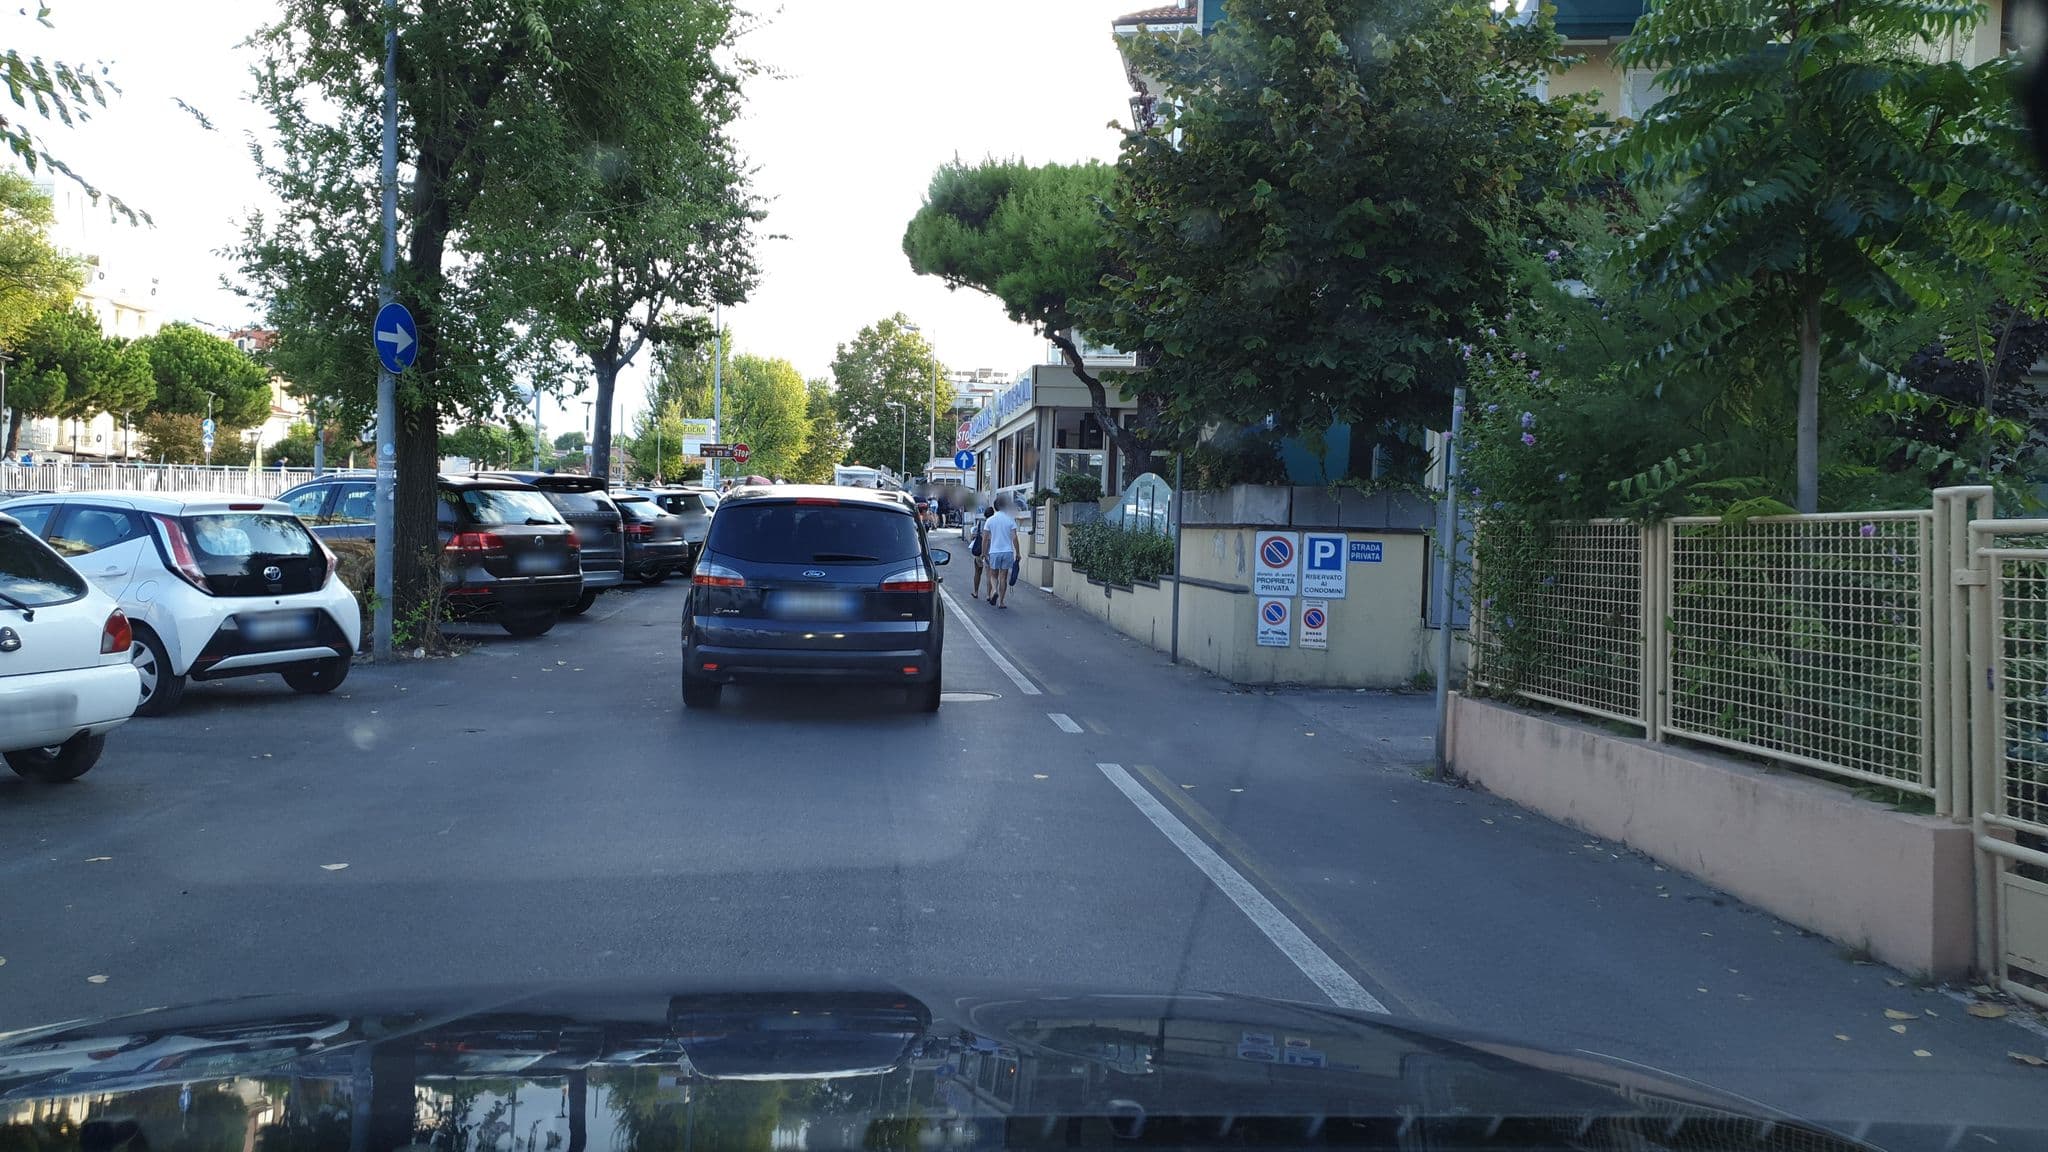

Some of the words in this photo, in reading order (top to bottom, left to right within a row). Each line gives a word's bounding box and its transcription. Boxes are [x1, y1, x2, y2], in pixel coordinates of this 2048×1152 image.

[1351, 543, 1381, 551] STRADA
[1313, 541, 1336, 567] P
[1350, 552, 1380, 560] PRIVATA
[1304, 586, 1344, 594] CONDOMINI
